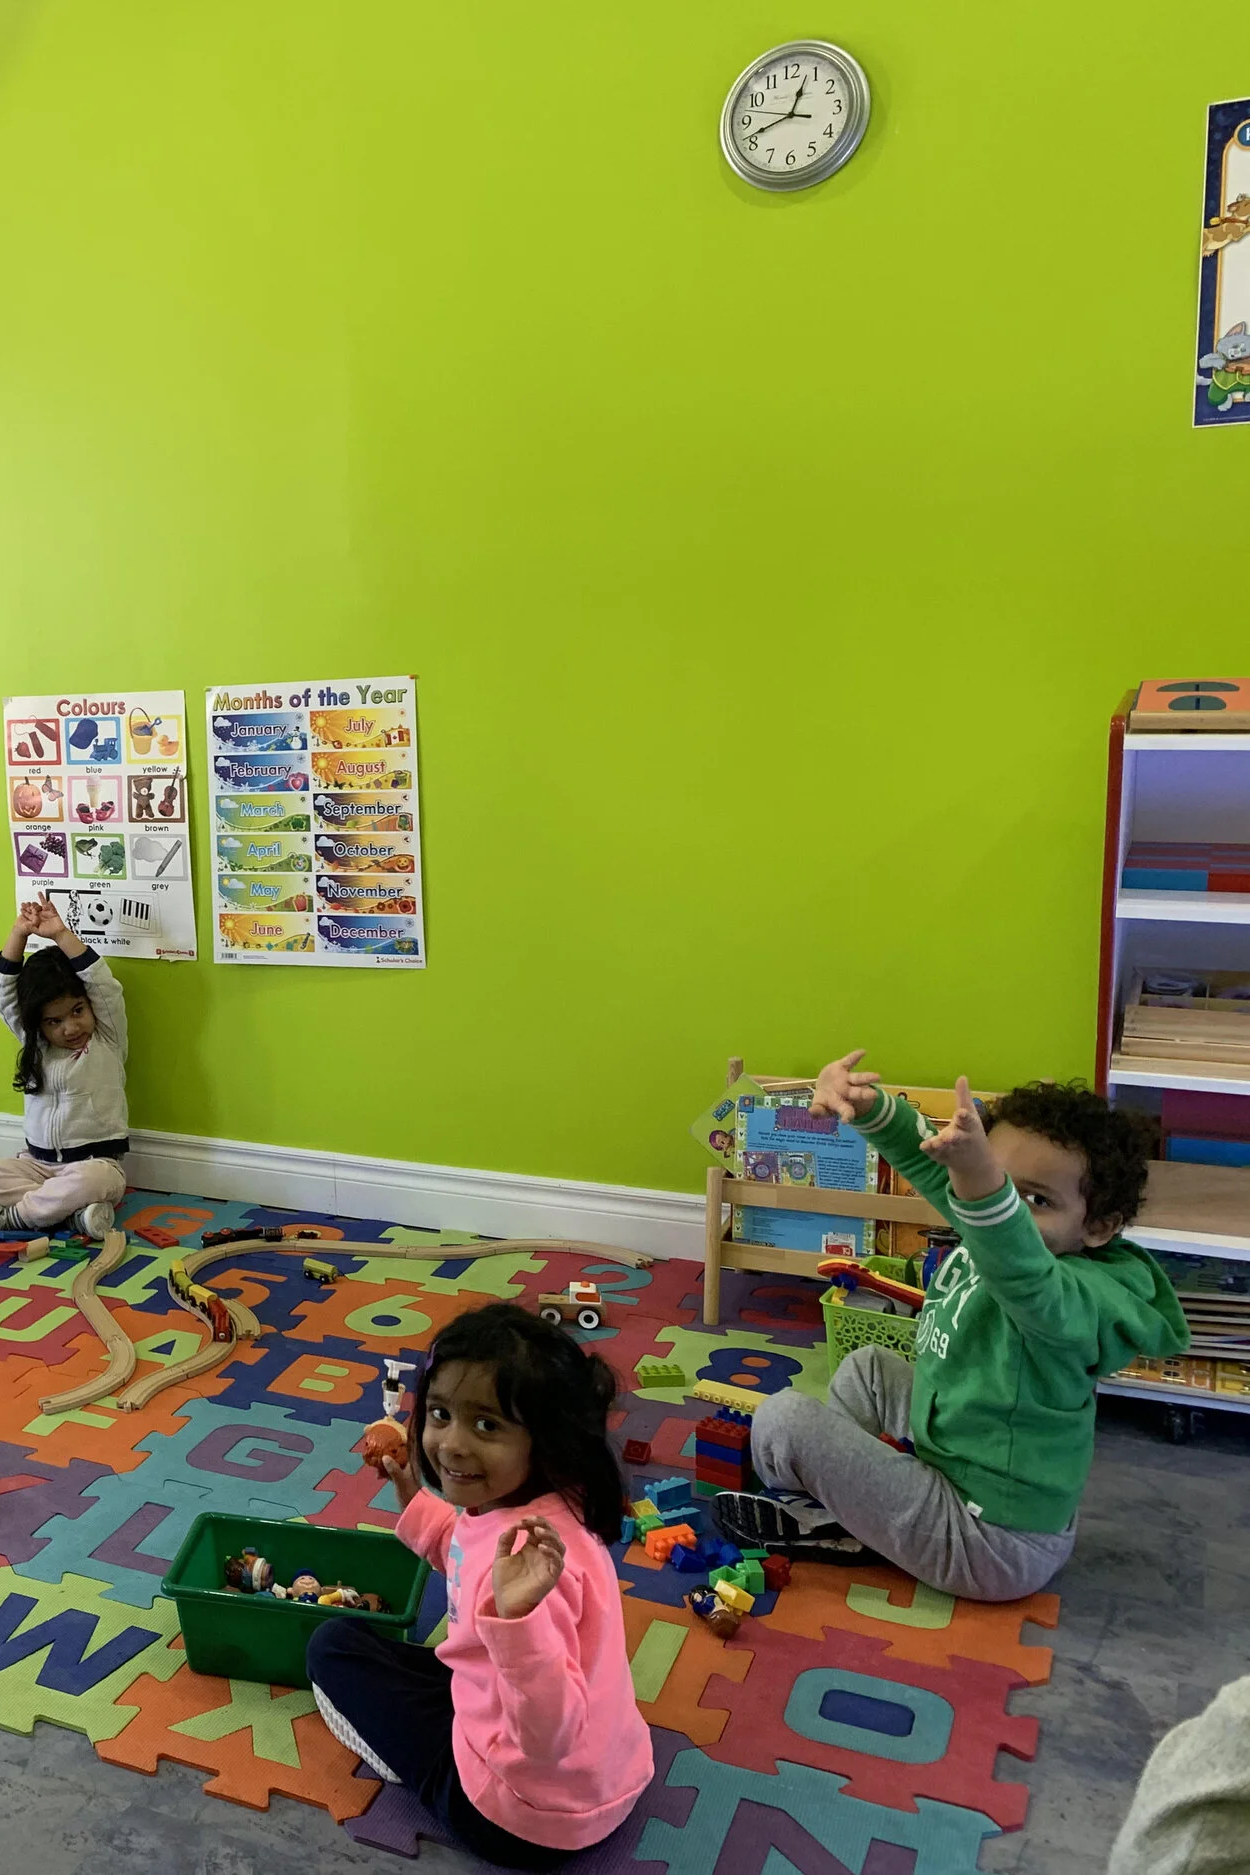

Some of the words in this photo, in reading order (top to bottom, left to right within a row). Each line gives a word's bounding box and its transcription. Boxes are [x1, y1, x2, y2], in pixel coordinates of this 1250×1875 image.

[783, 63, 800, 80] 12
[813, 66, 818, 81] 1
[765, 74, 778, 90] 11
[825, 79, 835, 95] 2
[750, 91, 765, 108] 10
[832, 99, 842, 115] 3
[742, 115, 752, 130] 9
[823, 123, 834, 138] 4
[748, 135, 759, 151] 8
[807, 141, 817, 157] 5
[766, 148, 775, 163] 7
[786, 149, 796, 165] 6
[213, 689, 283, 711] Months
[290, 688, 311, 708] of
[318, 687, 350, 706] the
[356, 684, 407, 704] Year
[56, 699, 126, 717] Colours
[231, 722, 289, 740] January
[343, 716, 375, 736] July
[28, 767, 42, 775] red
[86, 767, 102, 775] blue
[142, 766, 168, 774] yellow
[229, 762, 294, 780] February
[336, 759, 386, 778] August
[240, 802, 285, 817] March
[325, 799, 402, 820] September
[88, 824, 104, 832] pink
[246, 841, 282, 861] April
[333, 842, 394, 857] October
[32, 879, 54, 887] purple
[152, 882, 169, 890] grey
[327, 882, 403, 899] November
[250, 883, 282, 900] May
[250, 921, 284, 936] June
[329, 924, 405, 939] December
[81, 937, 102, 945] black
[345, 1294, 433, 1337] 6
[930, 1327, 950, 1359] 69
[266, 1354, 380, 1404] B
[696, 1347, 804, 1396] 8
[186, 1424, 314, 1482] G
